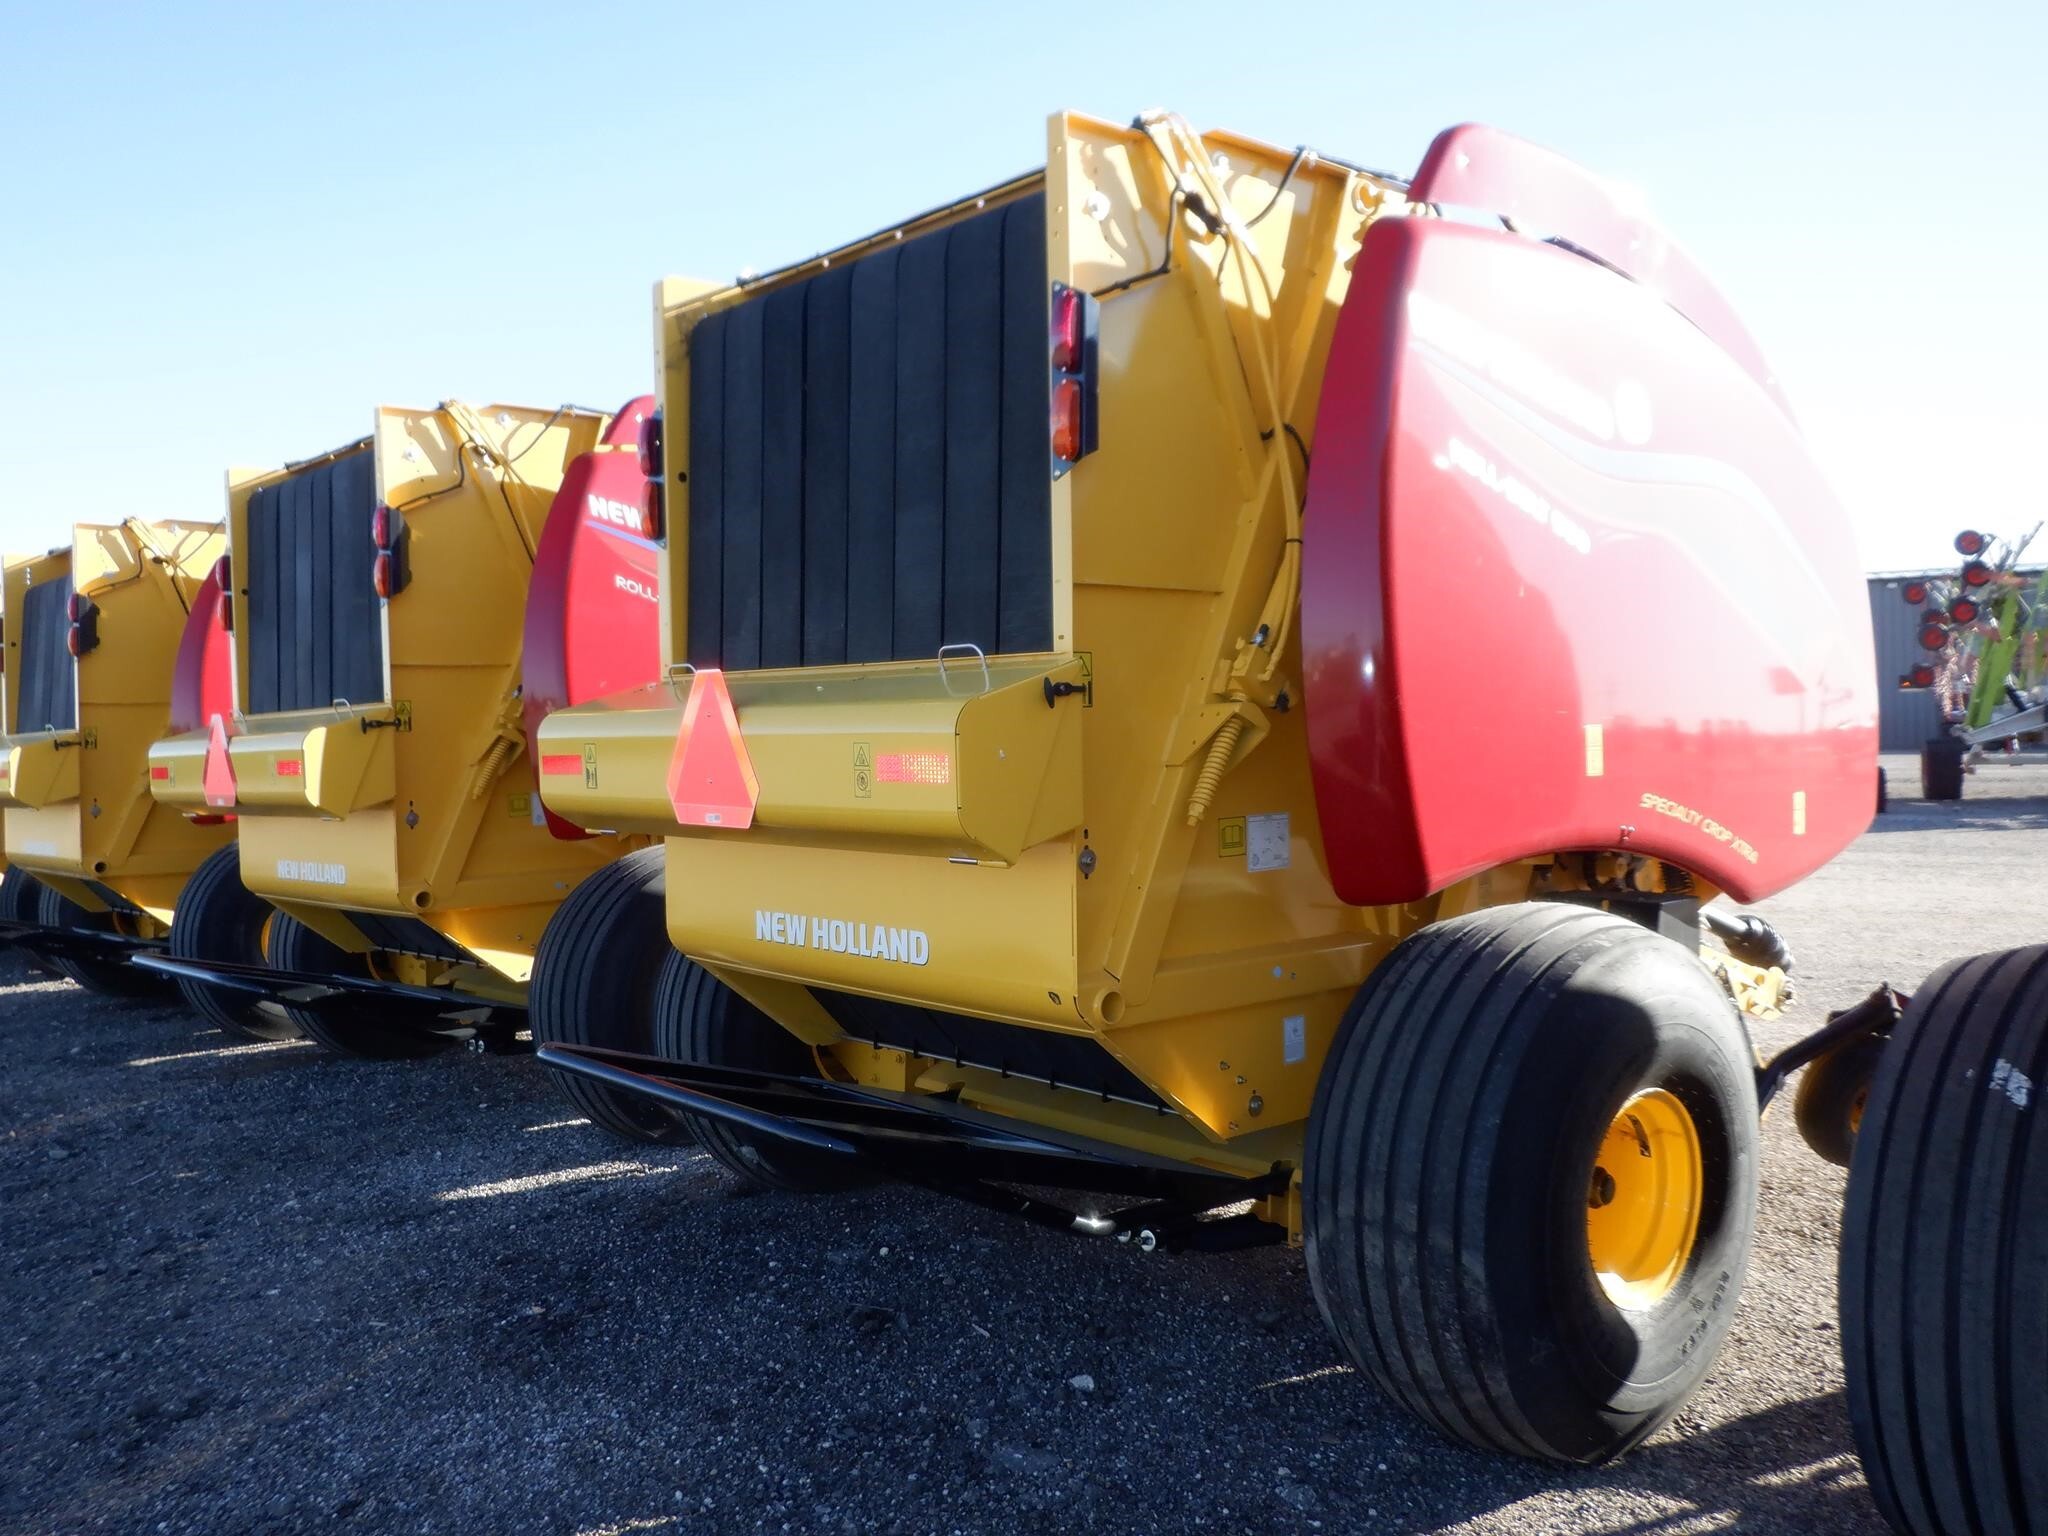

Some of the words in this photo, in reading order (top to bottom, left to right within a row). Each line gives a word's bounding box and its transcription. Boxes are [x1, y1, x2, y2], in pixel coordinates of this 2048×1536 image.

[1639, 792, 1703, 827] SPECIALTY
[1701, 818, 1733, 842] CROP
[277, 860, 299, 880] NEW
[300, 861, 347, 885] HOLLAND
[755, 910, 807, 947] NEW
[811, 916, 930, 967] HOLLAND
